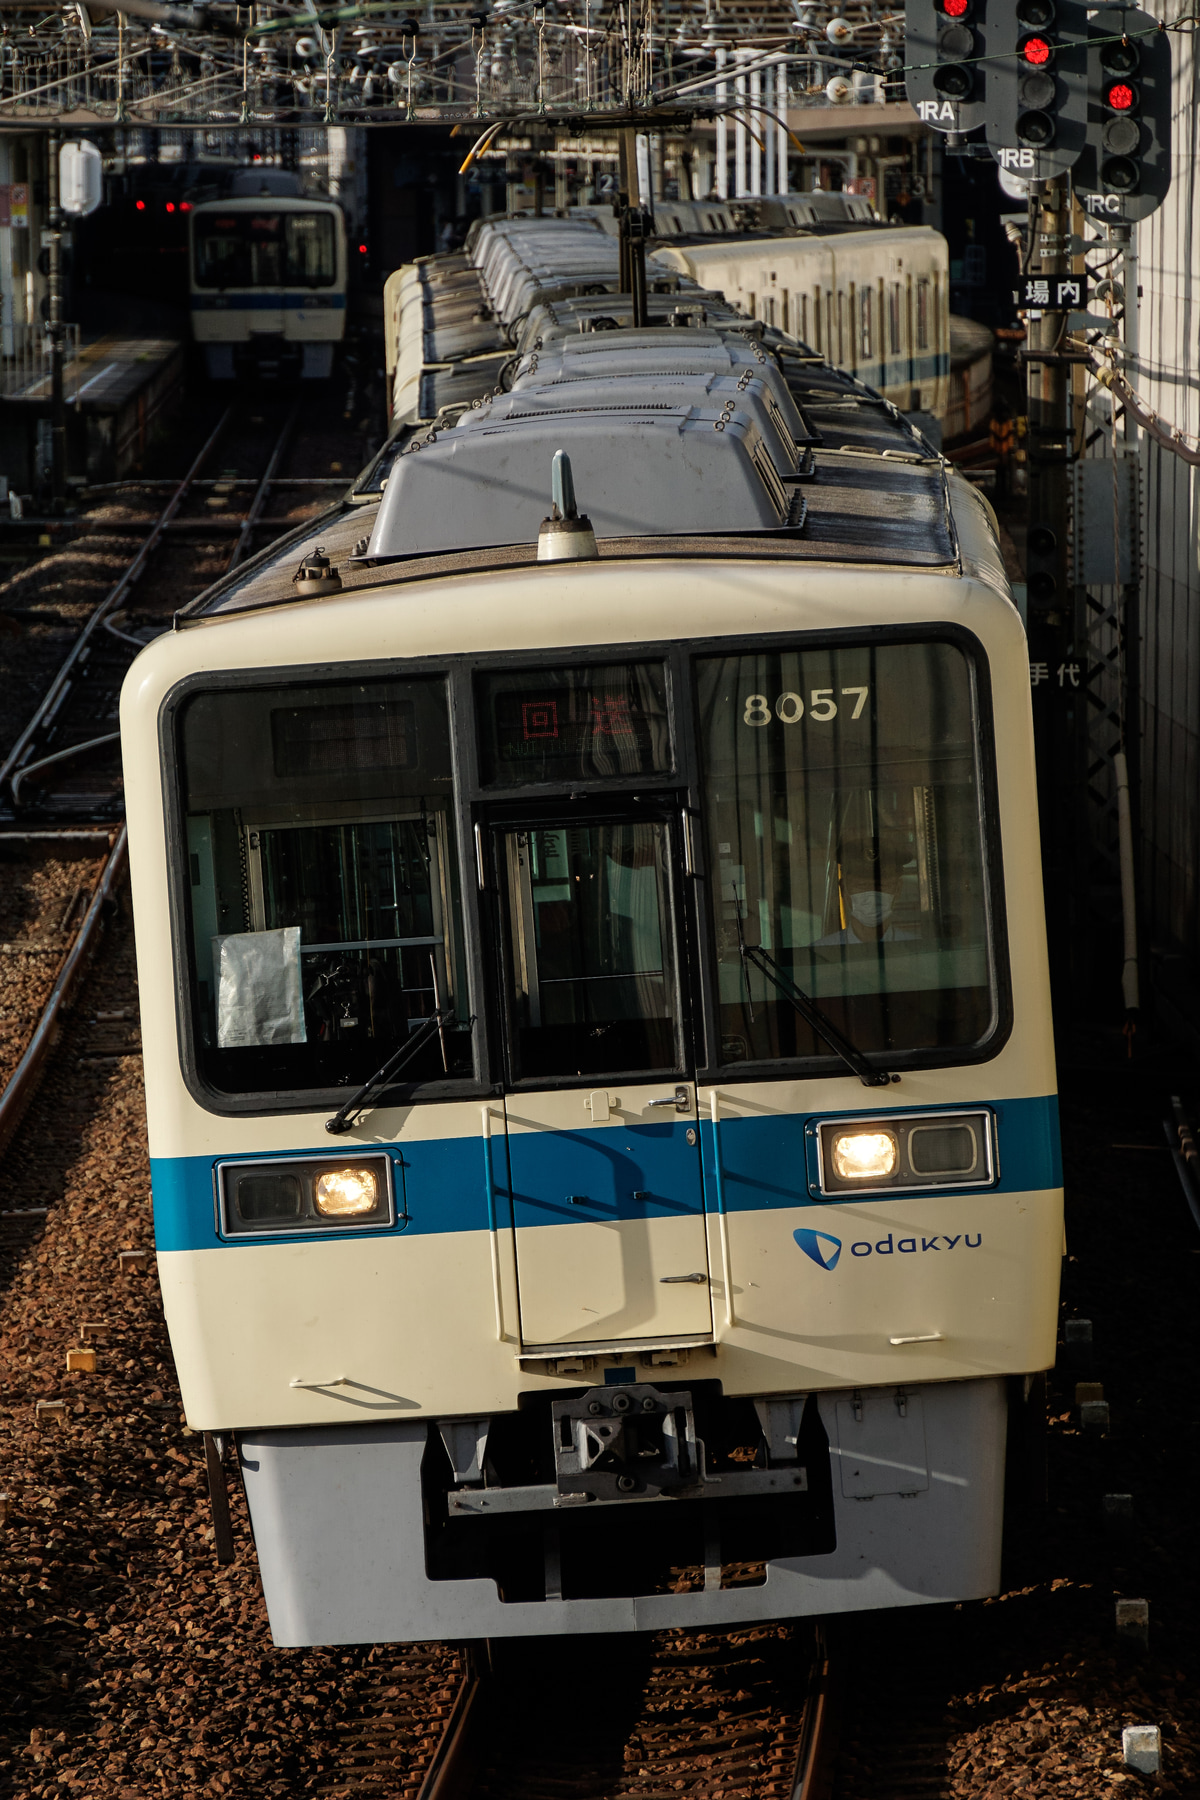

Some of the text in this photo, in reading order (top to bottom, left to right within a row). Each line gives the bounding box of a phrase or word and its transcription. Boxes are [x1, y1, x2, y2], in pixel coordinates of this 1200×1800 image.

[917, 101, 955, 121] 1RA
[997, 148, 1035, 168] 1RB
[599, 174, 615, 192] 2
[912, 175, 926, 196] 3
[1084, 195, 1120, 214] 1RC
[1025, 280, 1081, 305] 場内
[1030, 662, 1080, 687] 手代
[743, 686, 869, 727] 8057
[851, 1233, 982, 1257] odakyu
